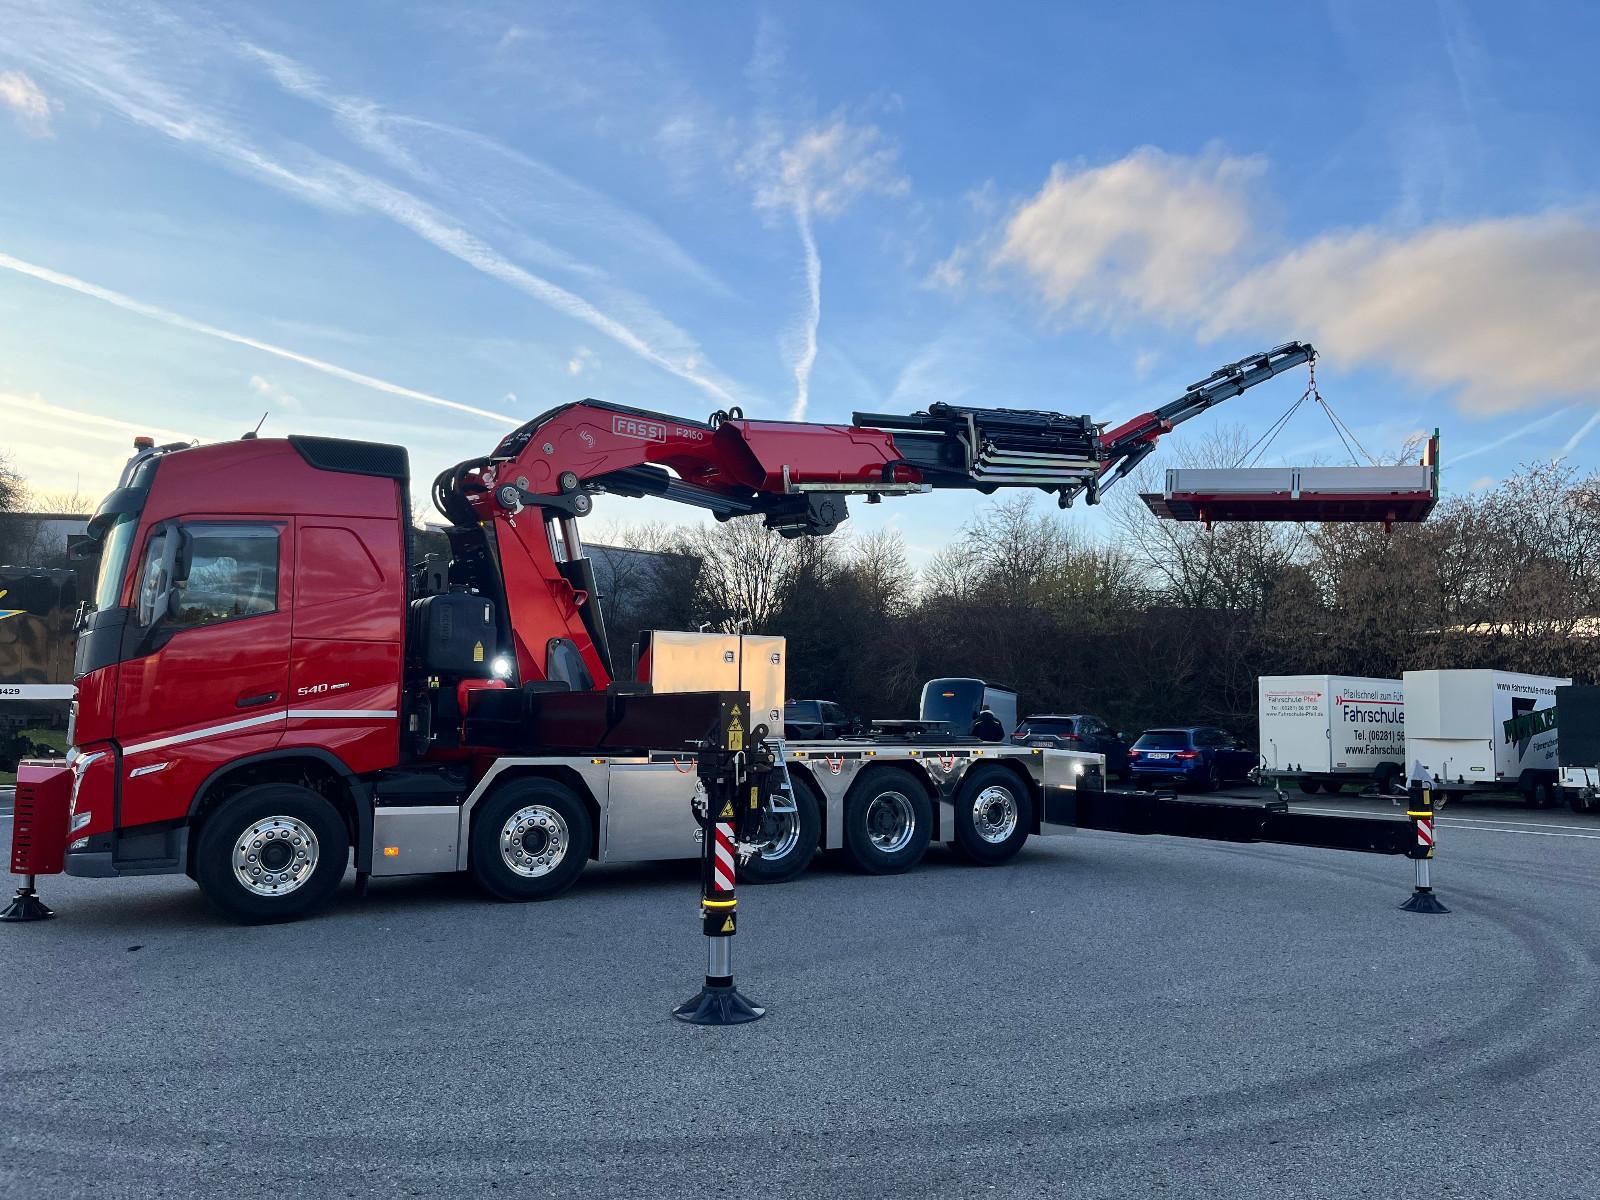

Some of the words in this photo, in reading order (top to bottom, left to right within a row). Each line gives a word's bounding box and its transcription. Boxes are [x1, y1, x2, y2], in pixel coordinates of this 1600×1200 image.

[617, 420, 662, 439] FASSI
[676, 427, 703, 441] F2150
[298, 683, 328, 695] 540
[1343, 705, 1405, 724] Fahrschule
[1354, 729, 1367, 741] Tel.
[1368, 730, 1395, 743] (06281)
